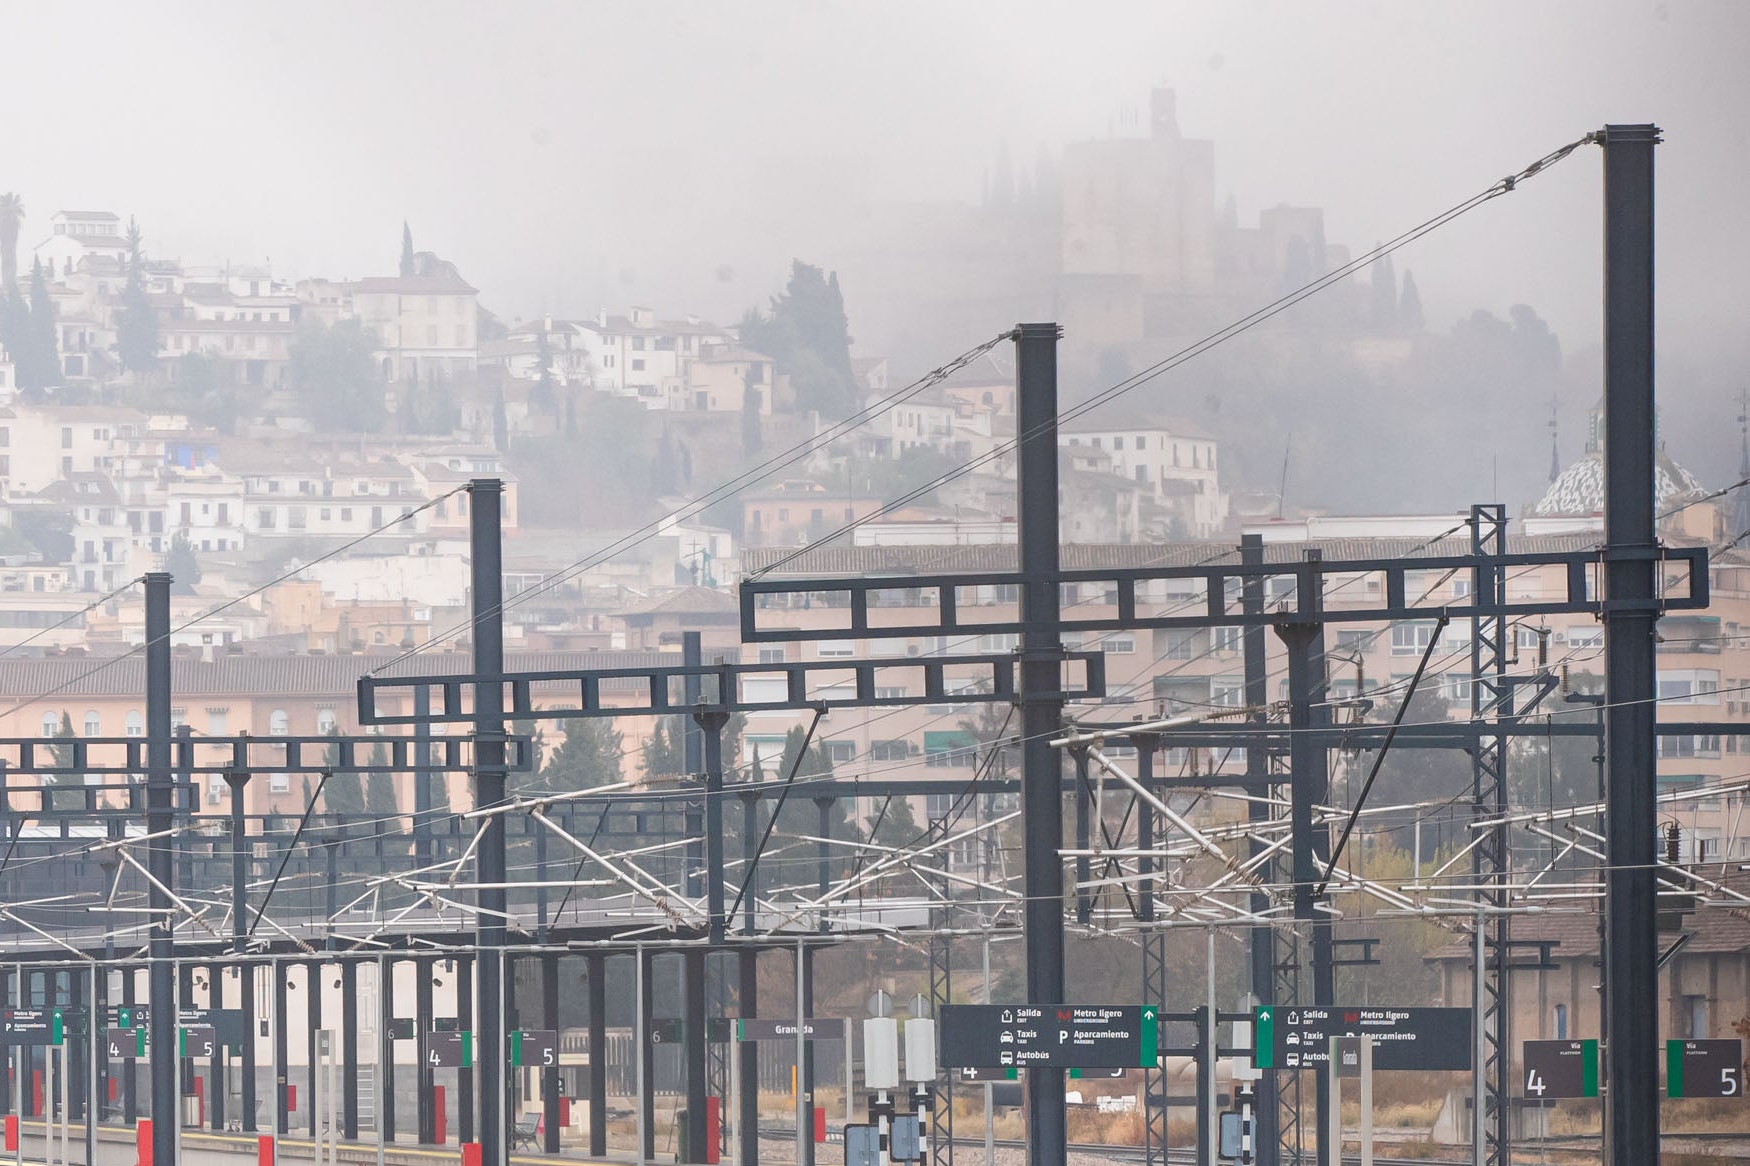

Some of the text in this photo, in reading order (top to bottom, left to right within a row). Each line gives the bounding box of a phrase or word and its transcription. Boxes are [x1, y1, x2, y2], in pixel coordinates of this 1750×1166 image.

[1017, 1009, 1041, 1017] Salida
[1074, 1009, 1097, 1017] Metro
[1303, 1010, 1328, 1019] Salida
[1360, 1011, 1384, 1019] Metro
[387, 1028, 395, 1039] 6
[775, 1025, 813, 1034] Granda
[1017, 1030, 1037, 1038] Taxis
[1074, 1030, 1129, 1039] Aparcamiento
[652, 1030, 661, 1042] 6
[1060, 1030, 1068, 1044] P
[1303, 1032, 1323, 1040] Taxis
[109, 1042, 120, 1056] 4
[204, 1042, 213, 1056] 5
[429, 1049, 441, 1065] 4
[543, 1048, 553, 1064] 5
[1017, 1051, 1050, 1059] Autobús
[1527, 1069, 1546, 1096] 4
[1721, 1068, 1737, 1095] 5
